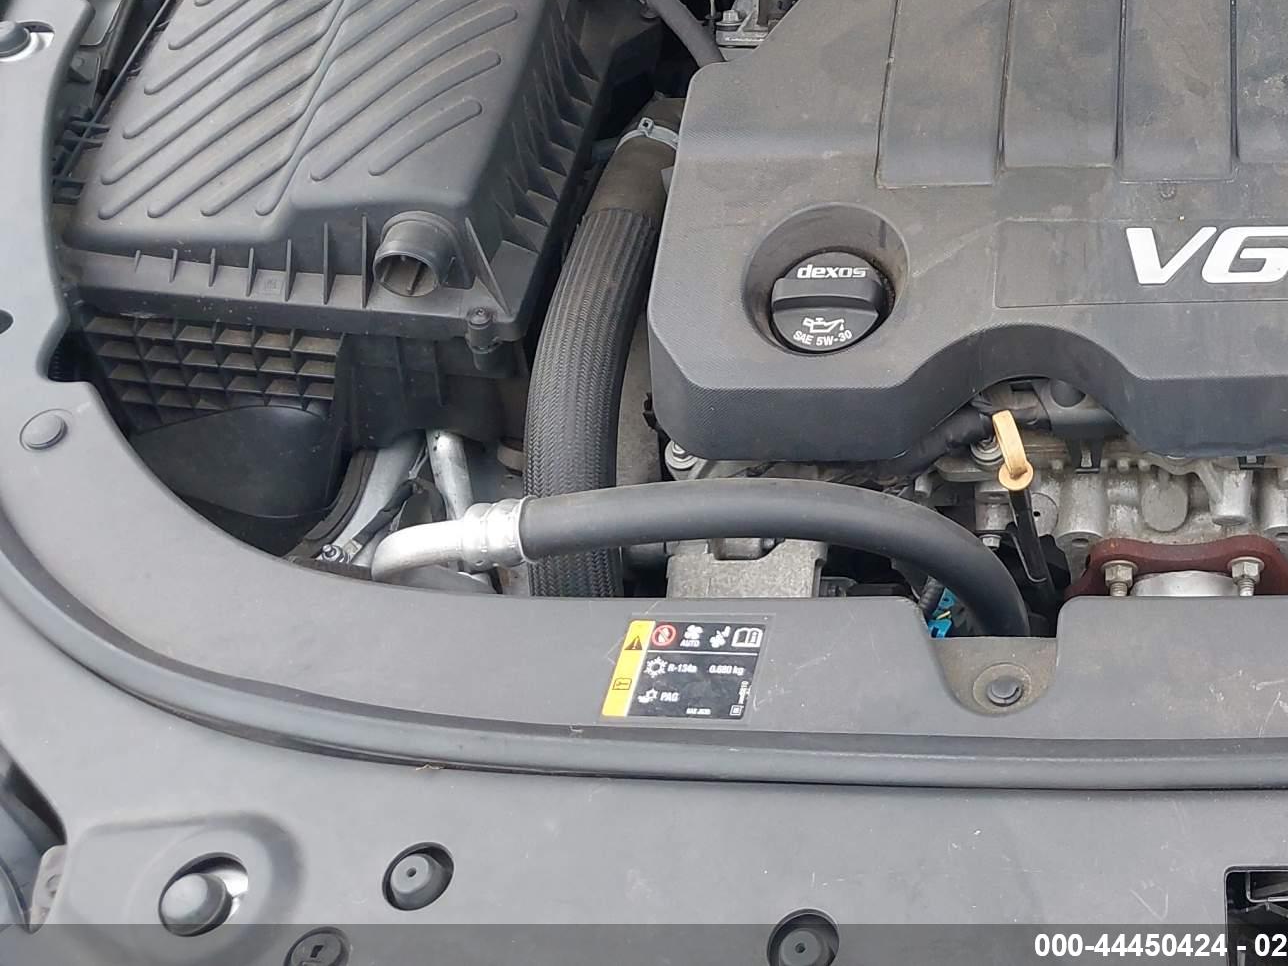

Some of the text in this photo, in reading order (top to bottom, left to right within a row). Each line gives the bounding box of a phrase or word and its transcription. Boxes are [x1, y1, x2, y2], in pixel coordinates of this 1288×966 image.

[797, 265, 867, 278] dexos
[793, 329, 853, 346] SAE 5W-30
[680, 639, 701, 647] AUTO
[667, 663, 698, 673] R-134a
[732, 665, 745, 676] kg
[660, 692, 679, 702] PAG
